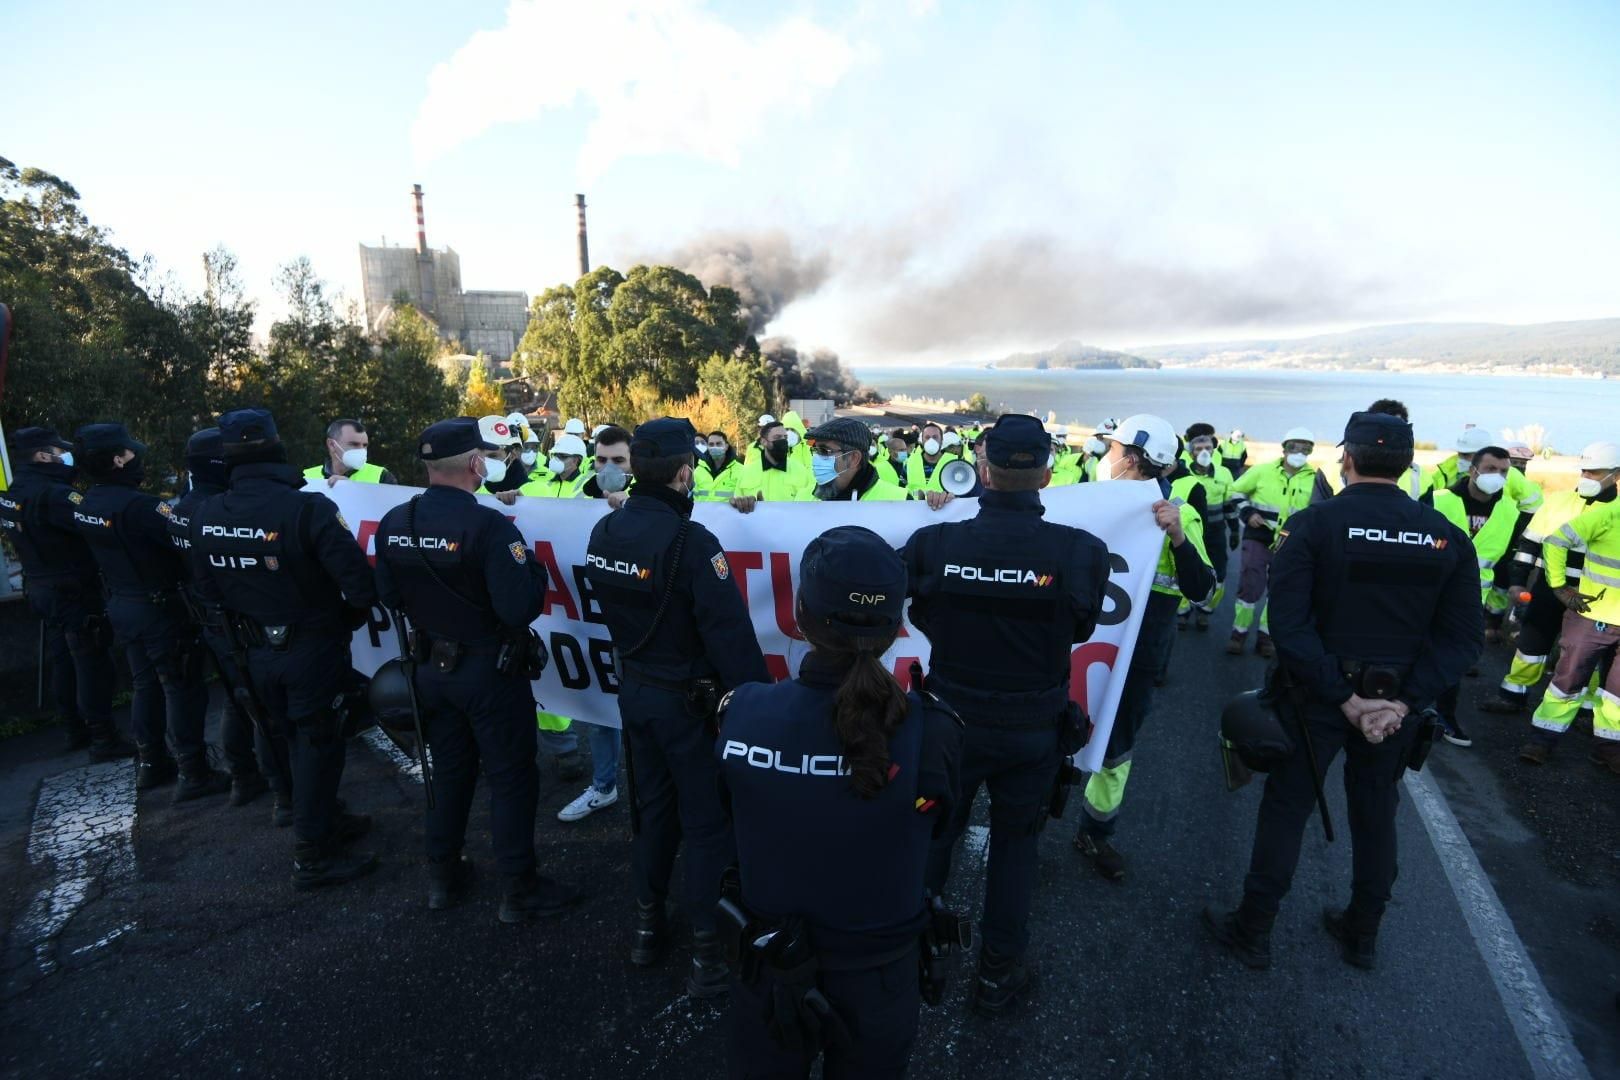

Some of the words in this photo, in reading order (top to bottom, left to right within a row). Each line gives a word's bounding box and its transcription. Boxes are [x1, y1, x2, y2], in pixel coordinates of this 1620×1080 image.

[74, 511, 105, 526] POLICIA
[202, 526, 267, 538] POLICIA
[1348, 527, 1435, 545] POLICIA
[388, 535, 449, 549] POLICIA
[209, 554, 258, 569] UIP
[586, 554, 641, 576] POLICIA
[944, 564, 1039, 583] POLICIA
[849, 592, 886, 606] CNP
[722, 739, 852, 776] POLICI
